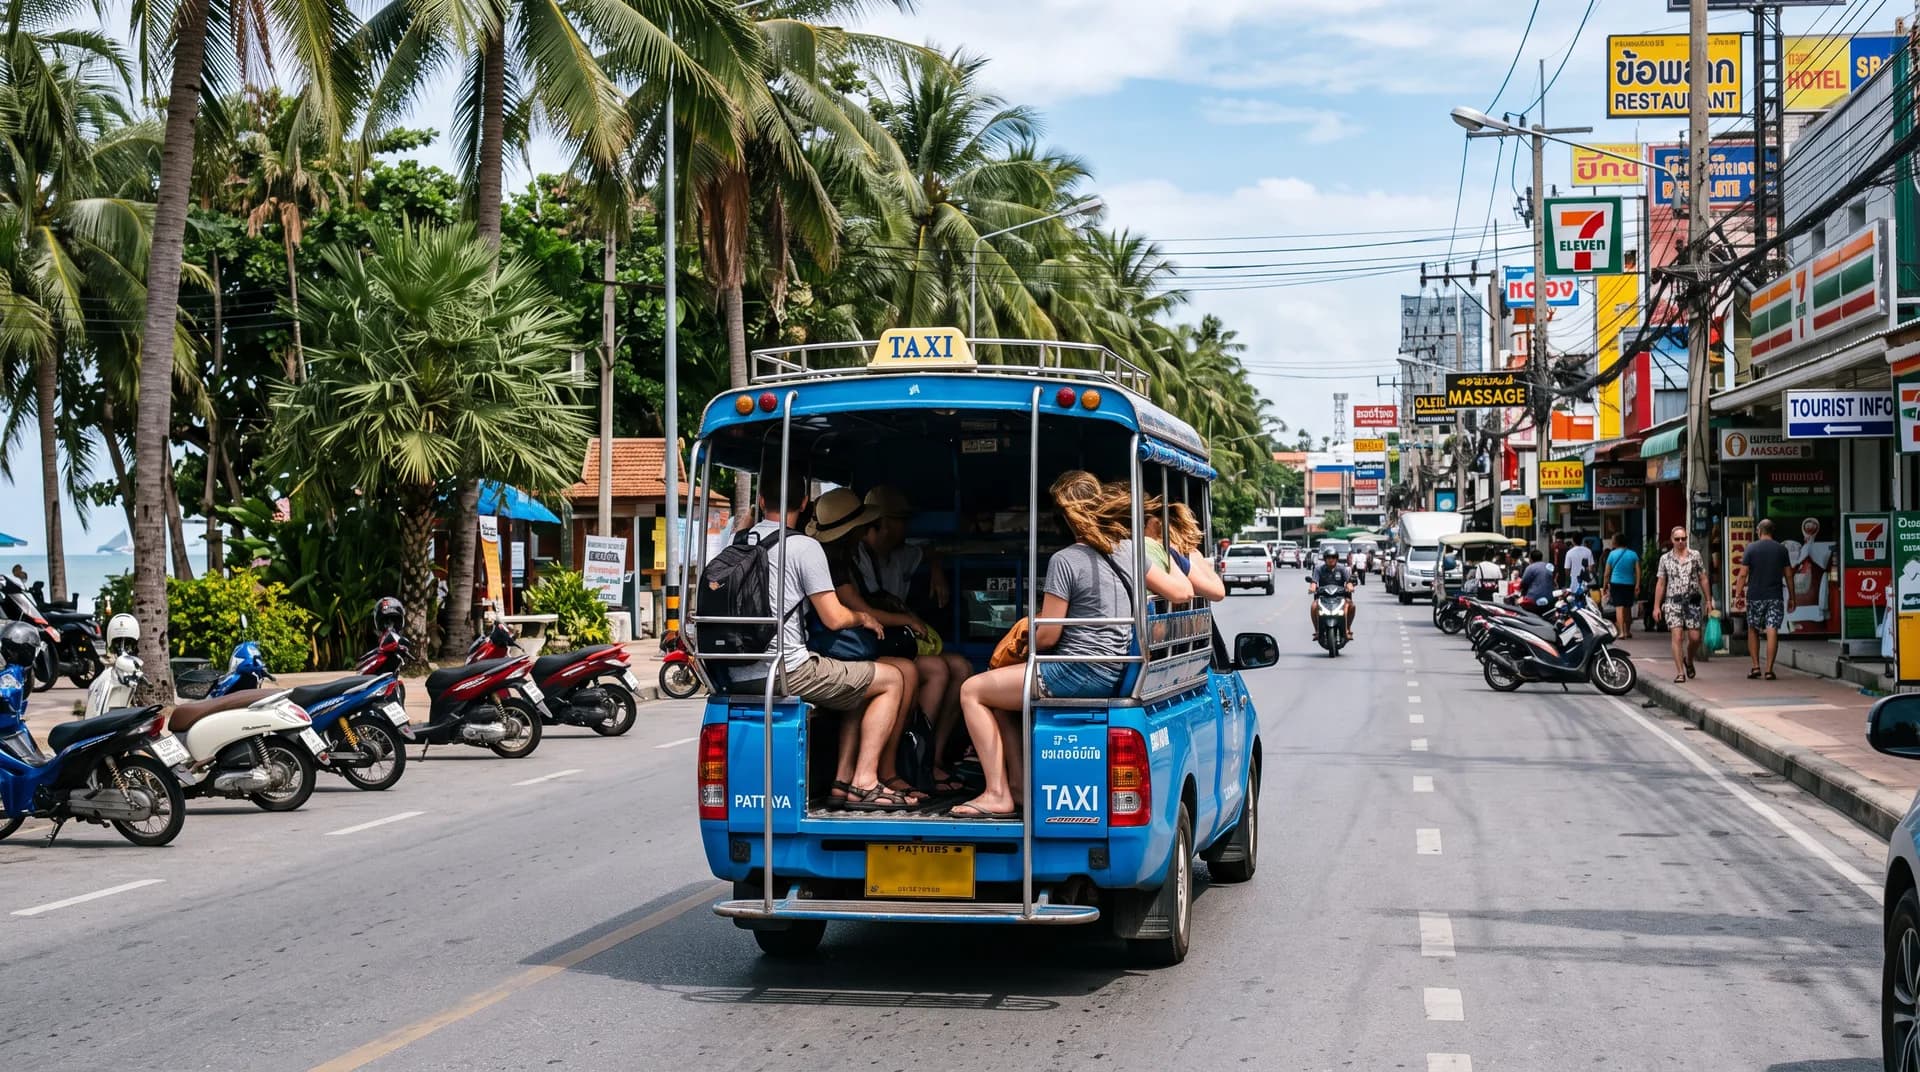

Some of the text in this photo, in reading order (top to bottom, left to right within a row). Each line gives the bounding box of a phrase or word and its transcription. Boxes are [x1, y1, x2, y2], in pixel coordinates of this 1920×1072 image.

[1788, 70, 1847, 90] HOTEL
[889, 336, 953, 358] TAXI
[1448, 388, 1525, 405] MASSAGE
[1790, 396, 1893, 417] TOURIST INFO
[1750, 445, 1800, 457] MASSAGE
[1041, 784, 1099, 812] TAXI
